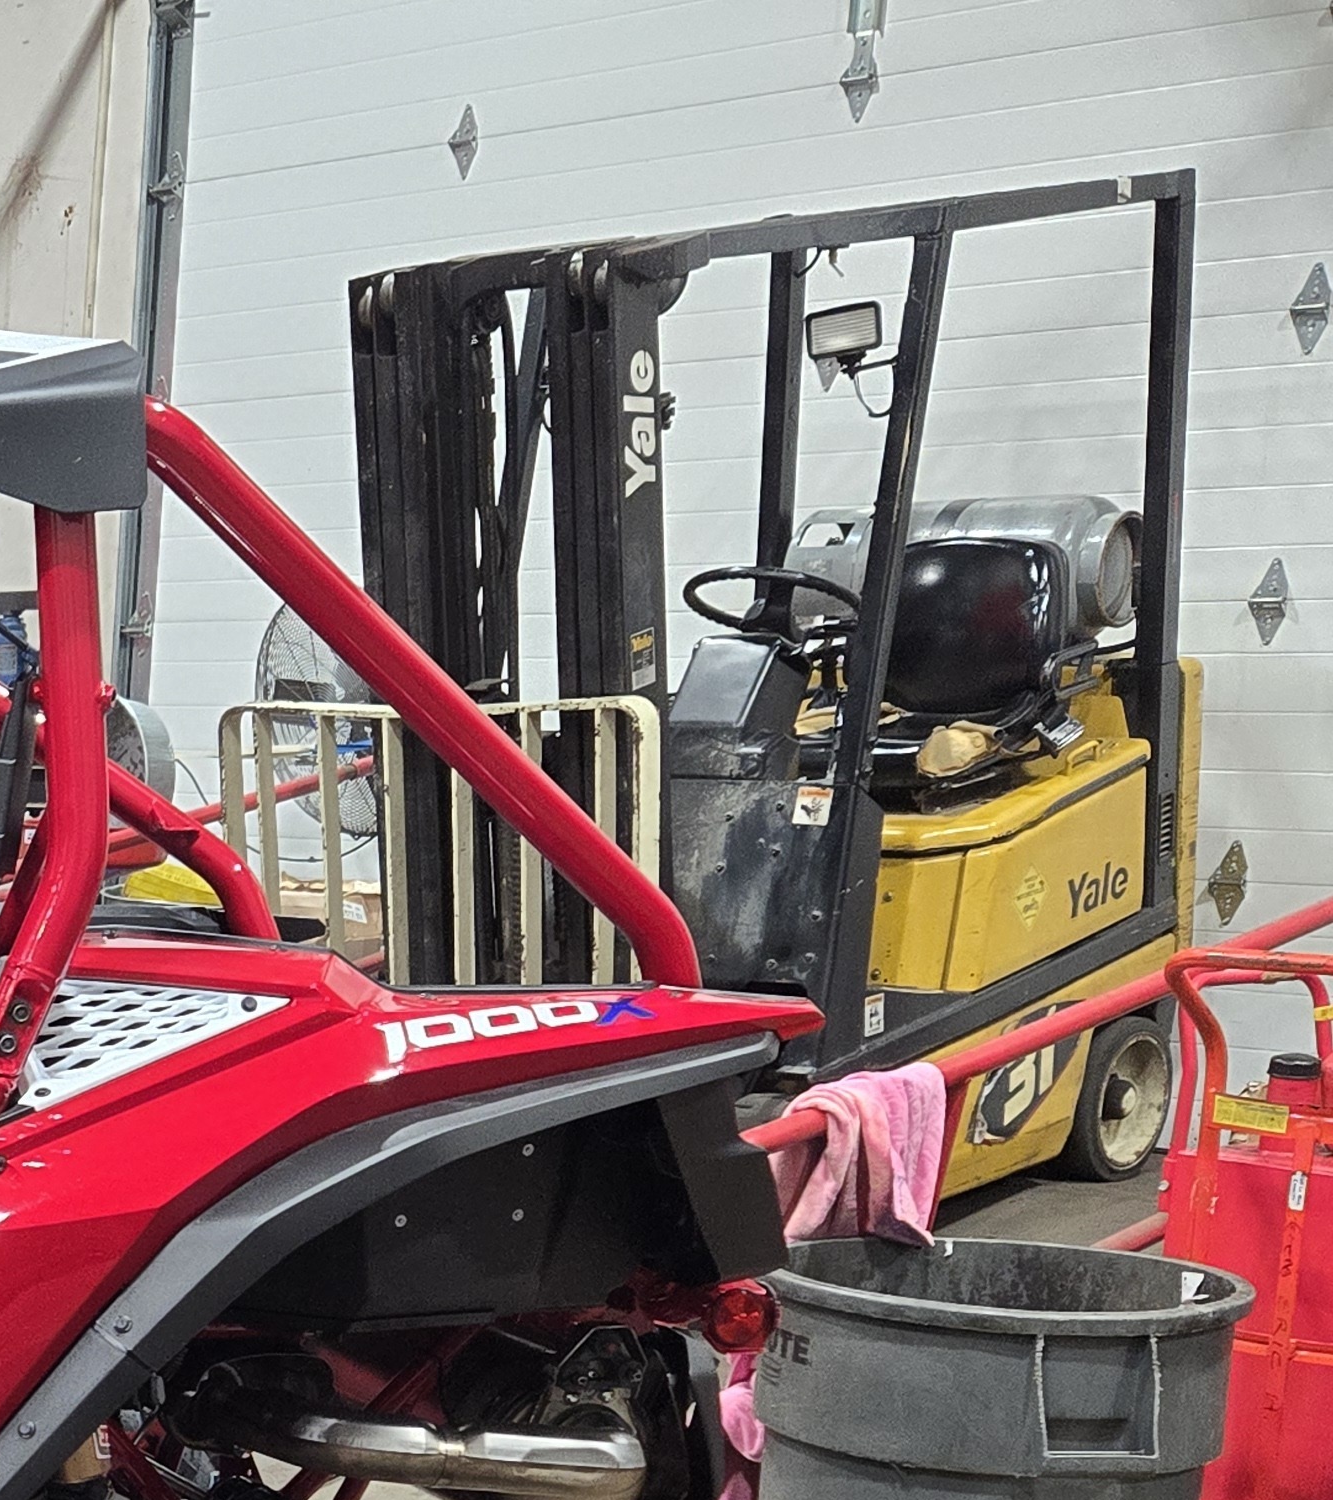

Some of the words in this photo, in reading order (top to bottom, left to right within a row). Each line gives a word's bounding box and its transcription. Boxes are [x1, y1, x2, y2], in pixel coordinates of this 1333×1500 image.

[623, 349, 656, 498] Yale
[1067, 861, 1129, 919] Yale
[374, 996, 656, 1064] 1000X
